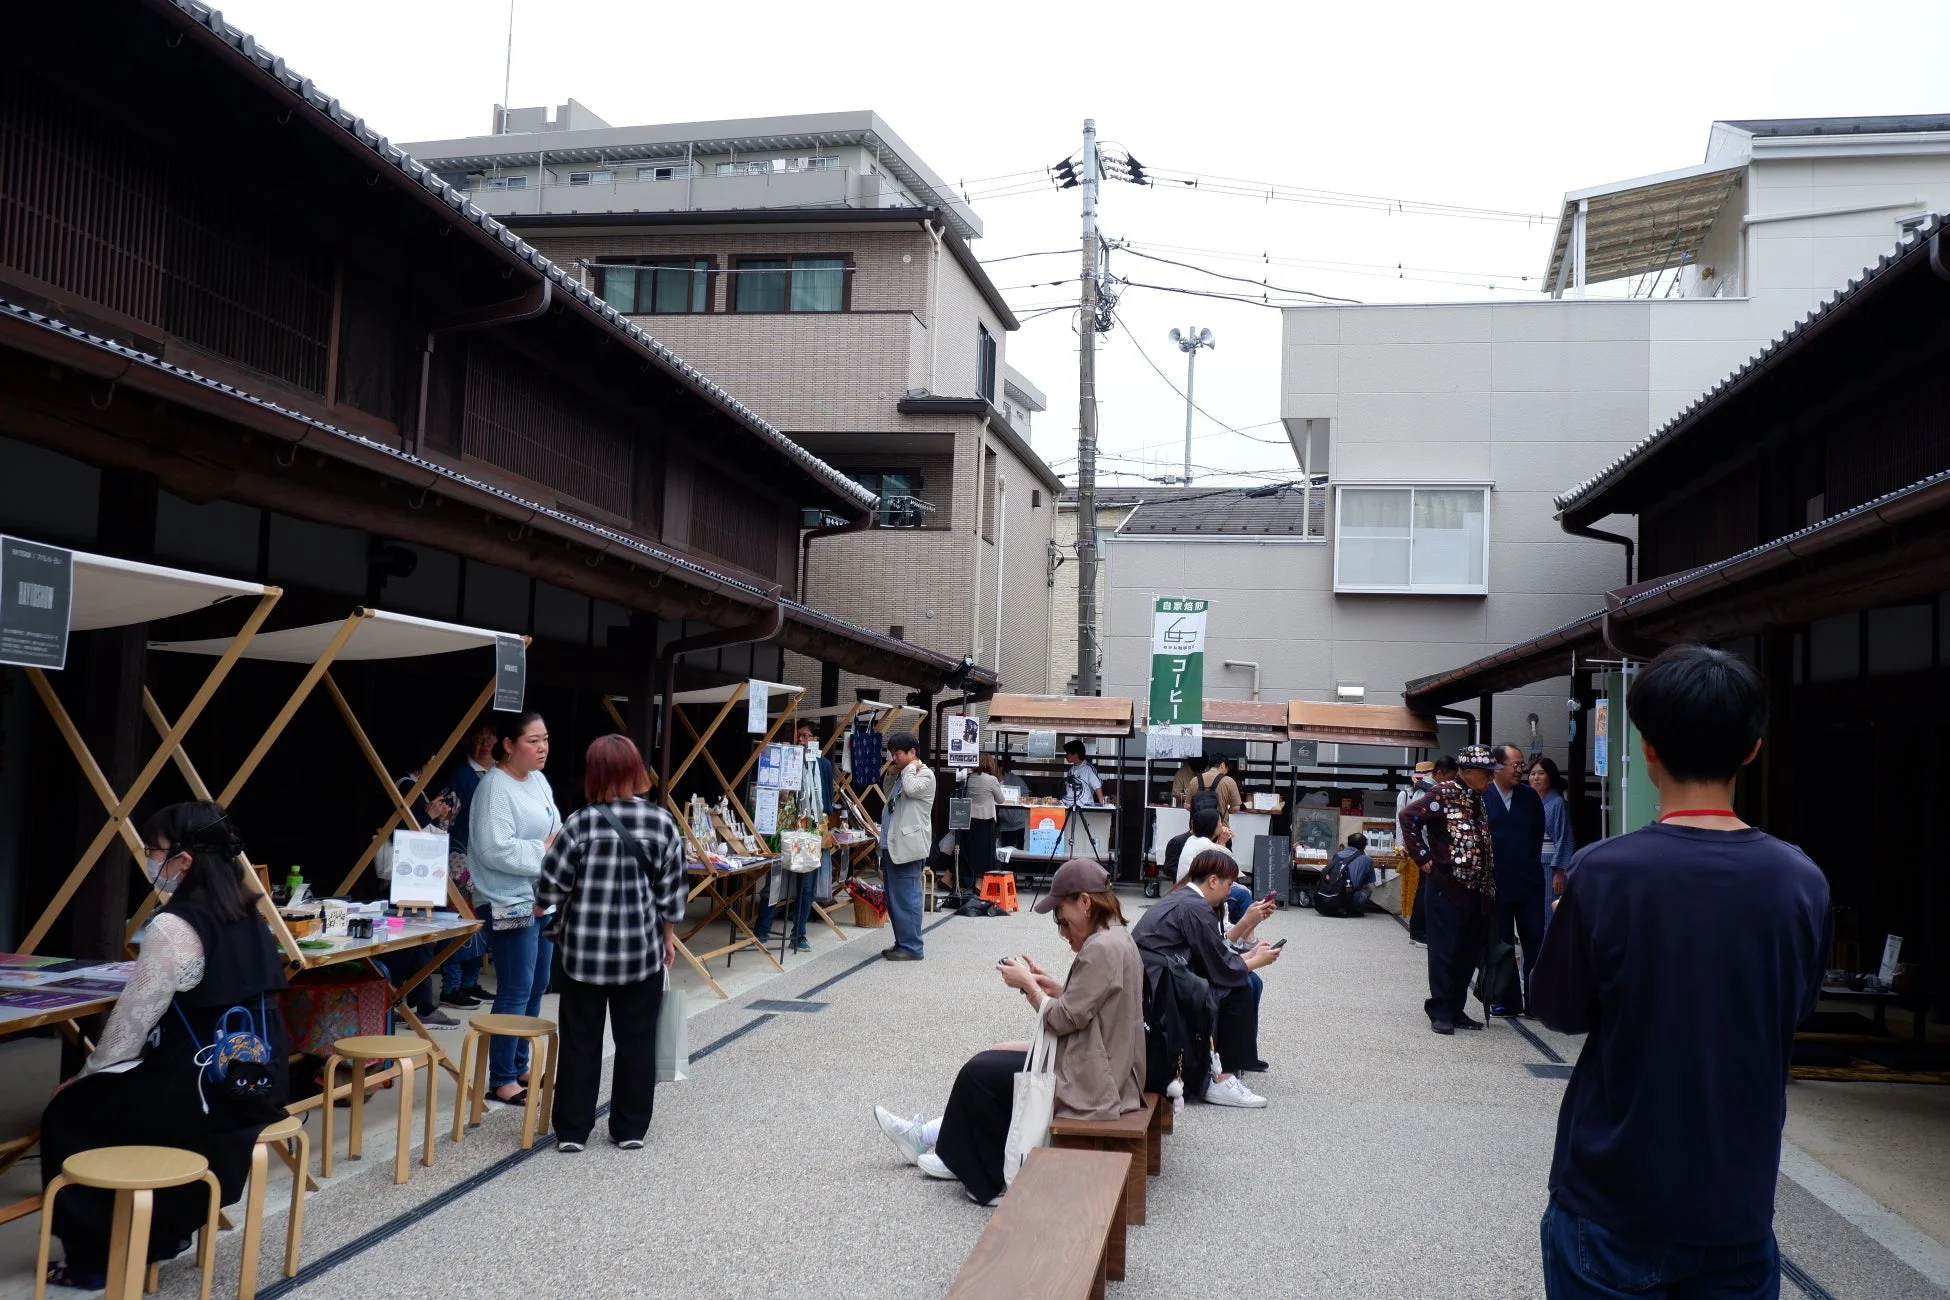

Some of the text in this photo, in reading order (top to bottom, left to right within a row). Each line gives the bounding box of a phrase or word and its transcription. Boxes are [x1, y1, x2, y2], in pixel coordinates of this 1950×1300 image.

[1163, 601, 1204, 611] 自家焙煎
[1169, 659, 1187, 720] コーヒー
